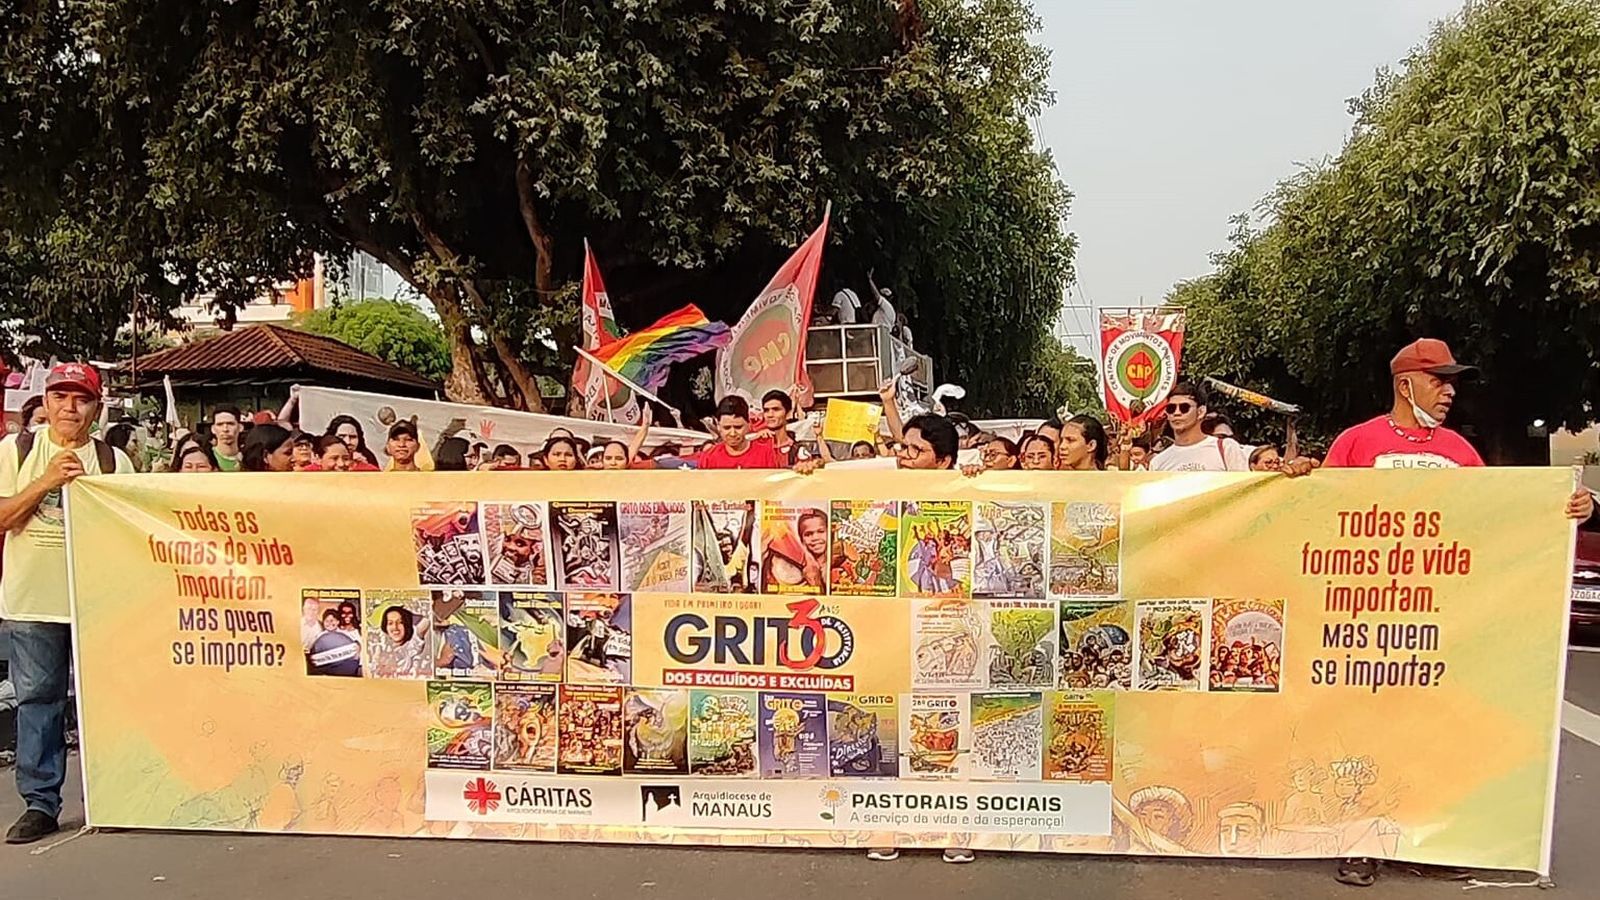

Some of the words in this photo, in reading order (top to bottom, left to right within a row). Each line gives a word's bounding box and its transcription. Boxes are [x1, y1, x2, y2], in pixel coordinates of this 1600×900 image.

[1393, 459, 1413, 469] EU
[172, 504, 230, 532] Todas
[234, 511, 259, 534] as
[1337, 503, 1406, 538] Todas
[1413, 511, 1441, 538] as
[149, 534, 217, 565] formas
[224, 536, 247, 565] de
[251, 538, 294, 566] vida
[1302, 542, 1380, 575] formas
[1387, 541, 1415, 575] de
[1422, 541, 1471, 575] vida
[175, 569, 272, 604] importam.
[1325, 579, 1440, 619] importam.
[179, 608, 218, 631] Mas
[225, 609, 275, 638] quem
[172, 641, 195, 665] se
[200, 636, 285, 672] importa?
[1322, 623, 1369, 649] Mas
[1376, 623, 1439, 657] quem
[665, 671, 692, 684] DOS
[696, 672, 766, 687] EXCLUÍDOS
[769, 675, 776, 687] E
[780, 675, 852, 690] EXCLUÍDAS
[1311, 659, 1337, 685] se
[1345, 654, 1446, 693] importa?
[505, 781, 592, 808] CÁRITAS
[692, 802, 772, 817] MANAUS
[693, 792, 757, 801] Arquidiocese
[759, 792, 772, 801] de
[852, 793, 968, 811] PASTORAIS
[976, 795, 1061, 812] SOCIAIS
[850, 812, 859, 822] A
[863, 812, 909, 826] serviço
[913, 813, 928, 824] da
[933, 813, 957, 824] vida
[962, 816, 969, 825] e
[974, 814, 989, 825] da
[993, 815, 1064, 829] esperança!
